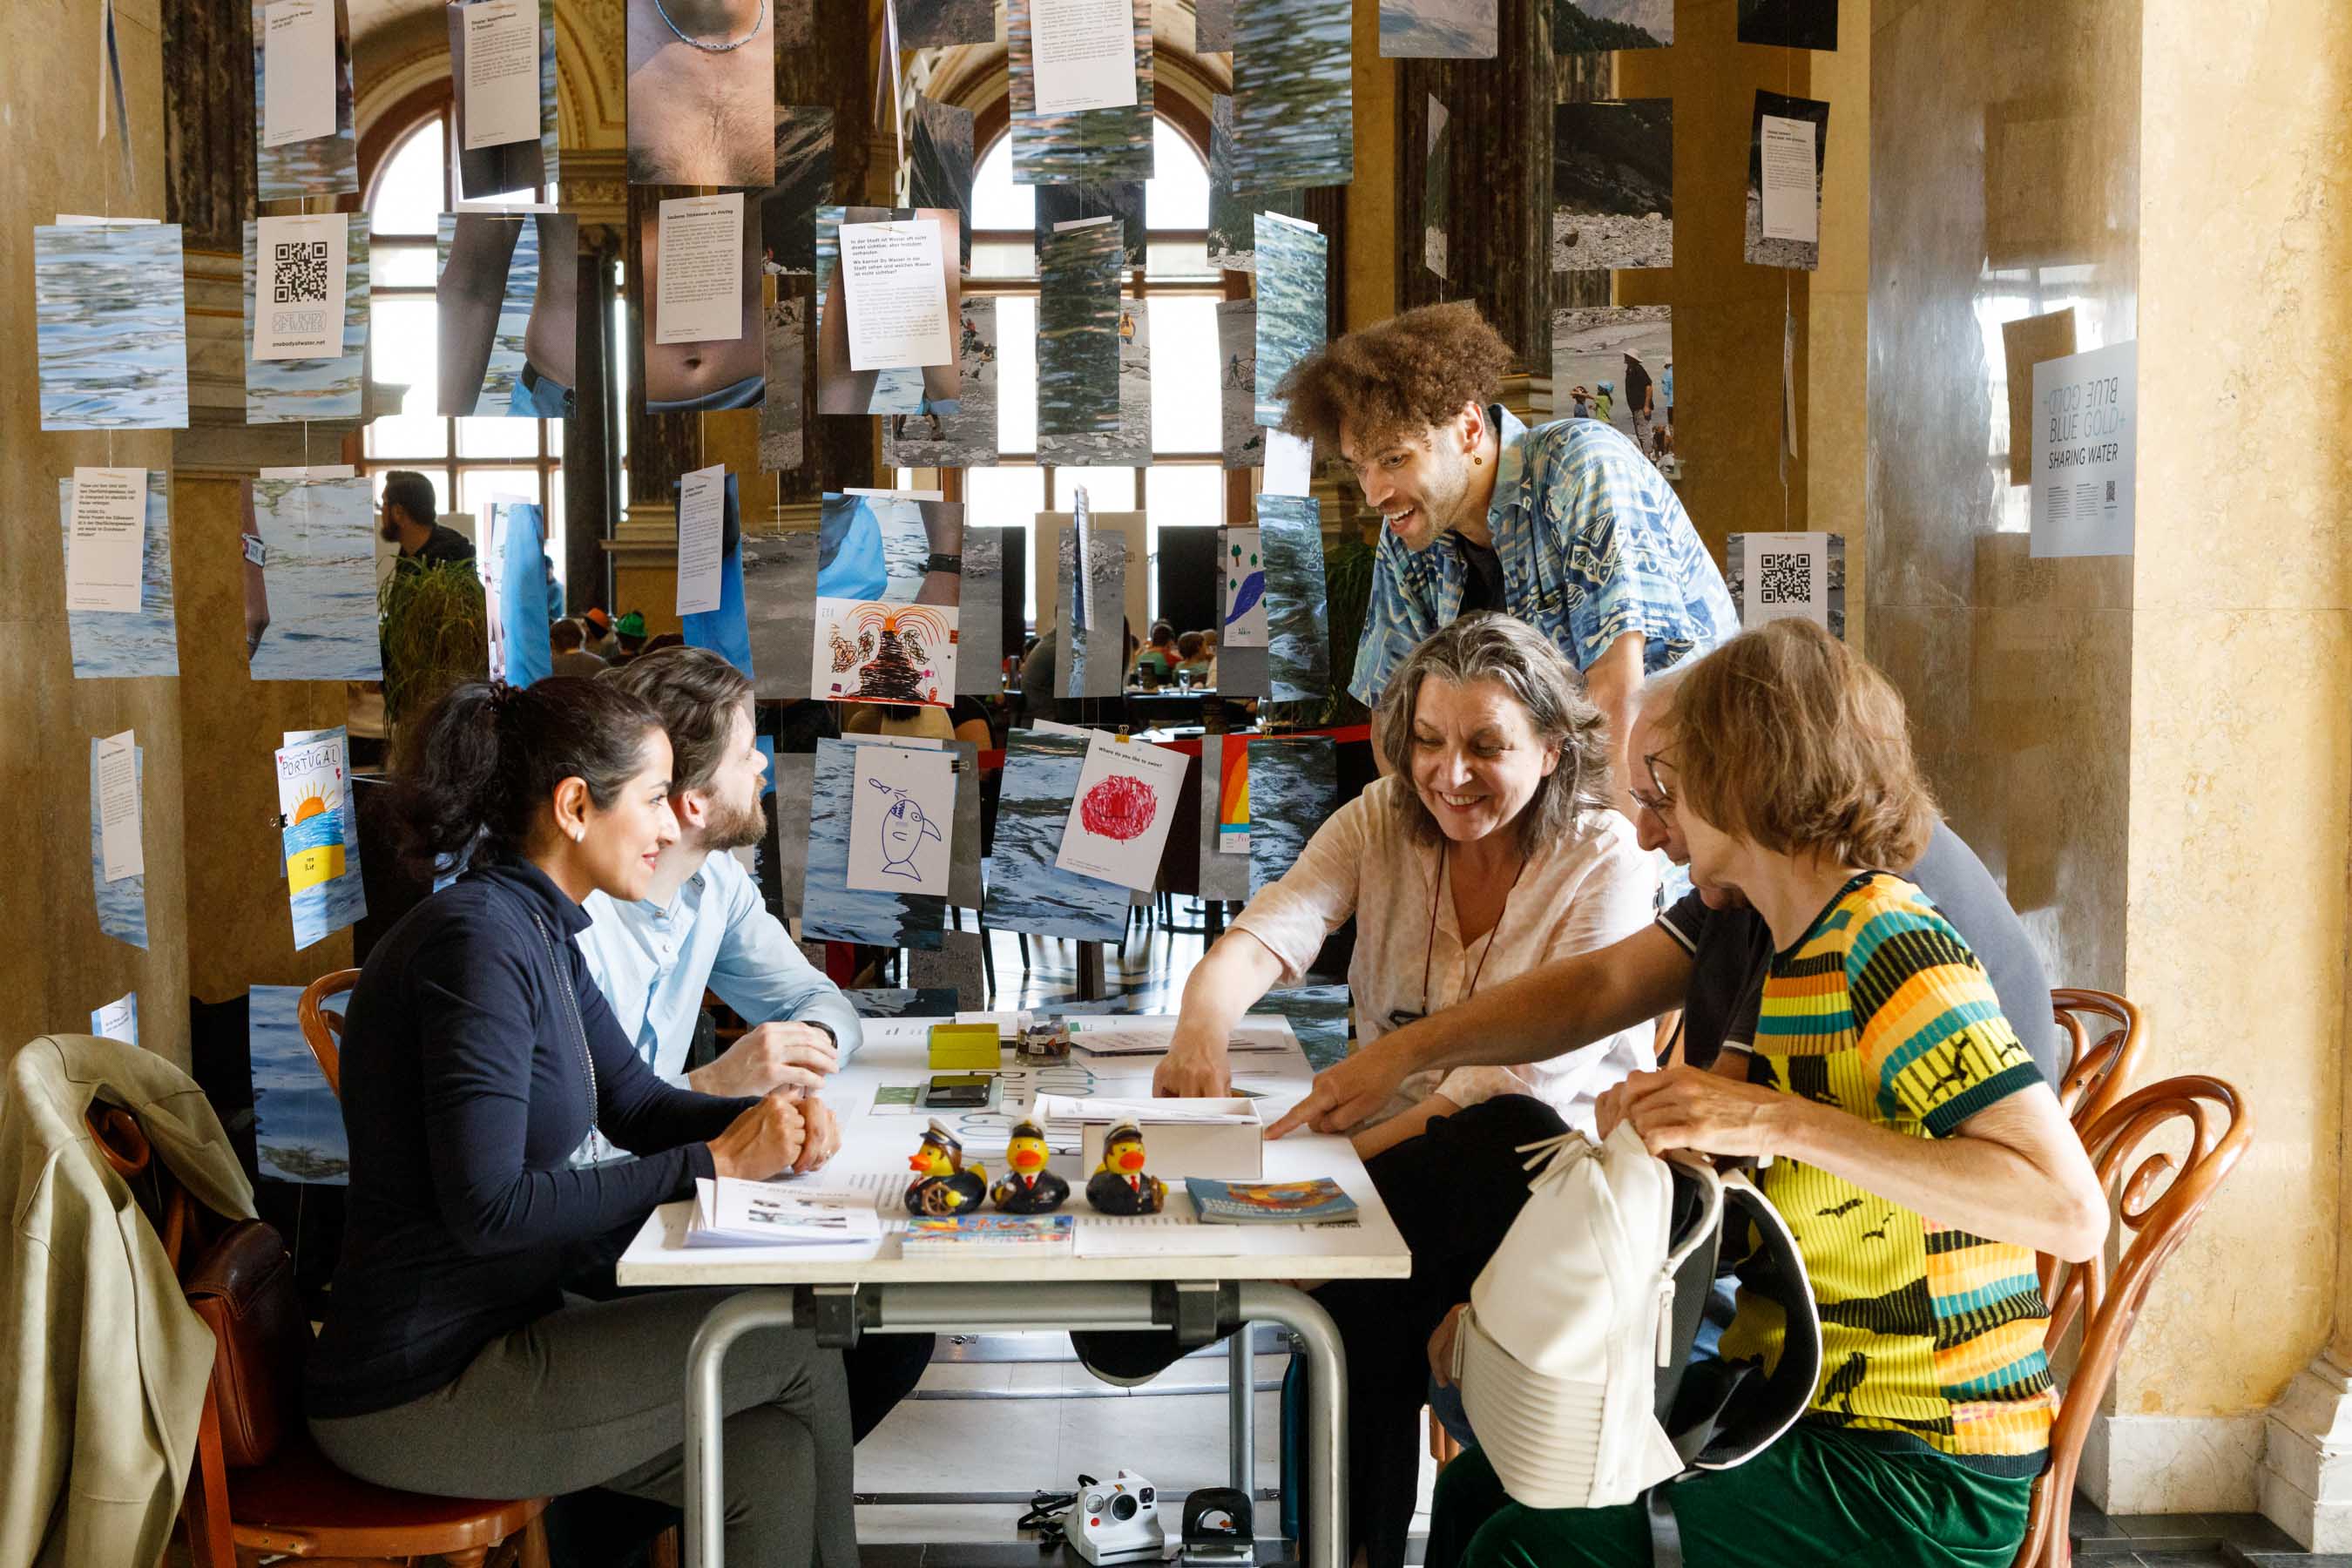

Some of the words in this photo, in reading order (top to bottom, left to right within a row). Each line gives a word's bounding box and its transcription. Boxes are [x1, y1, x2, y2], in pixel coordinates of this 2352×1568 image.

[2050, 414, 2078, 443] BLUE
[2049, 447, 2085, 470] SHARING
[2088, 443, 2119, 465] WATER
[282, 749, 336, 775] PORTUGAL
